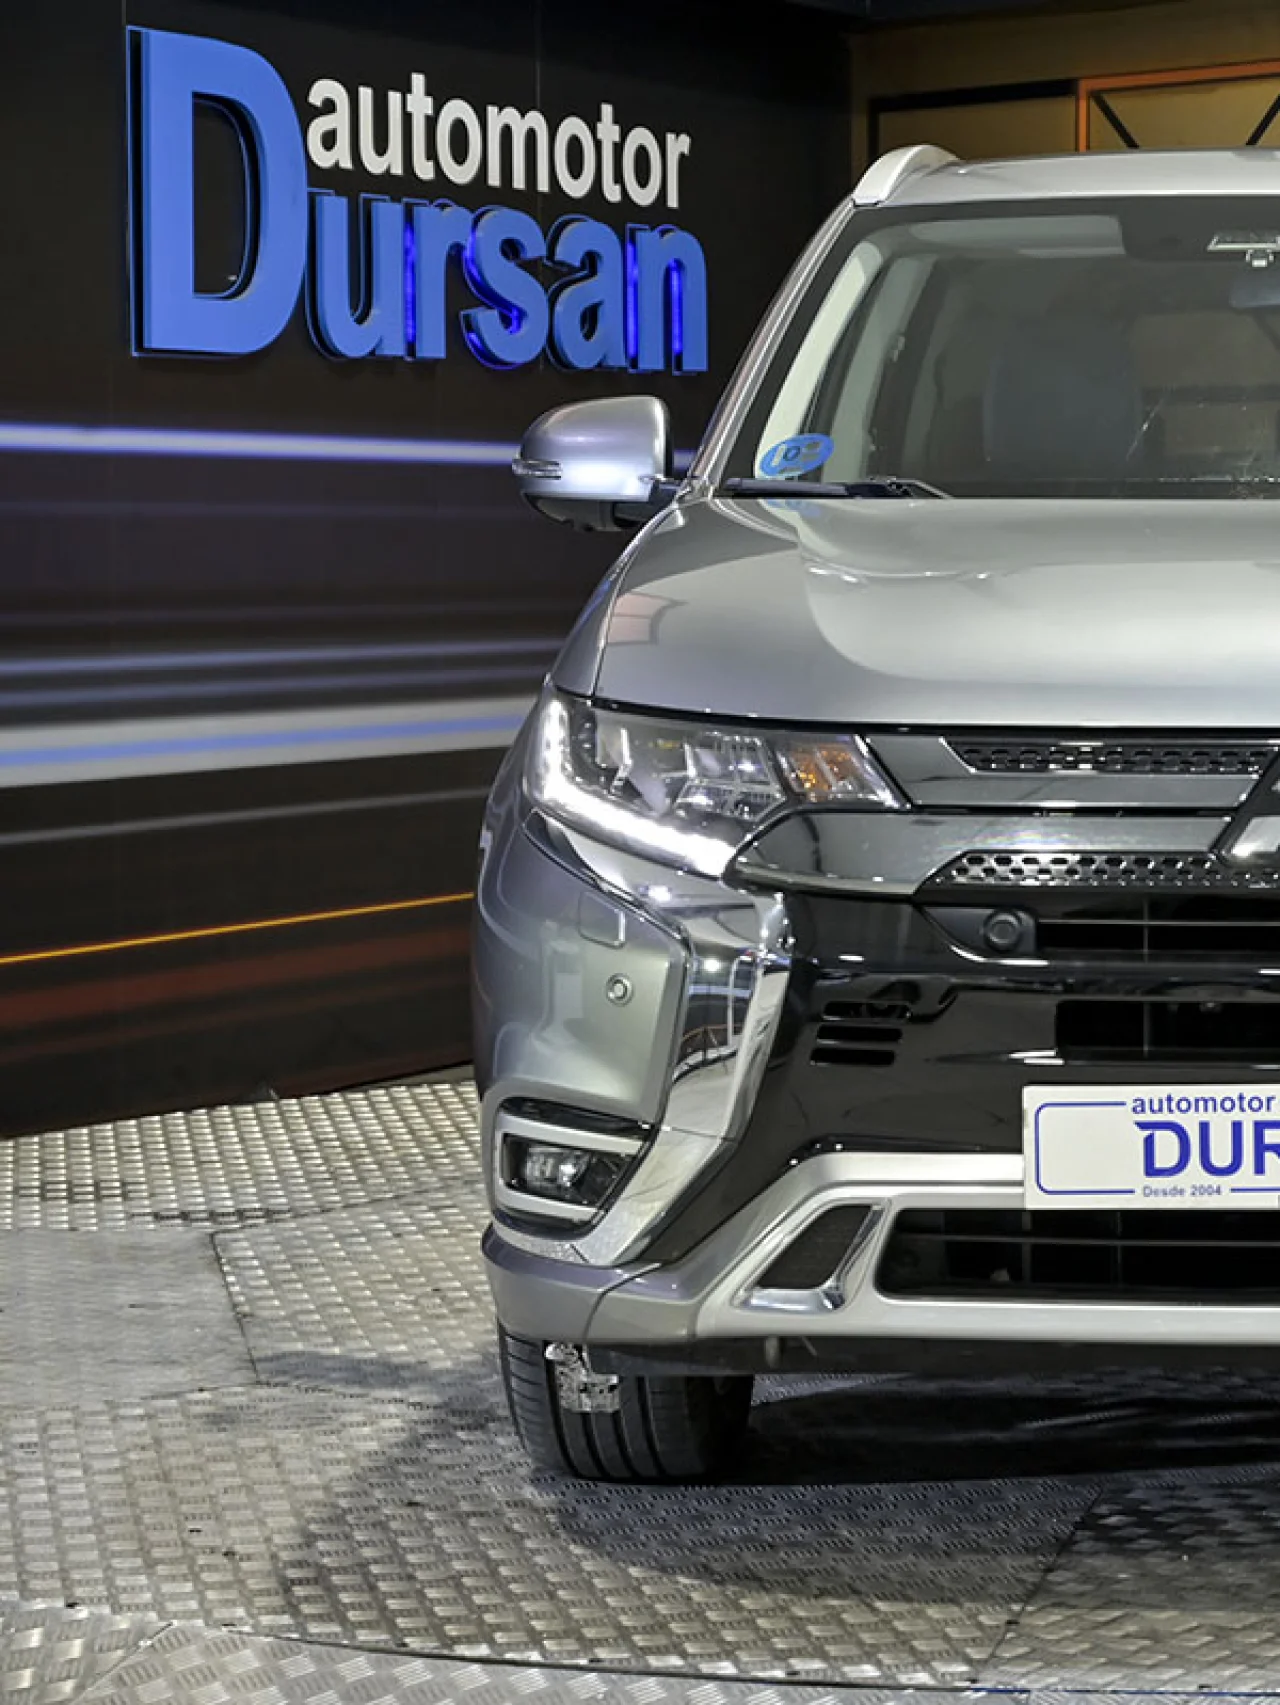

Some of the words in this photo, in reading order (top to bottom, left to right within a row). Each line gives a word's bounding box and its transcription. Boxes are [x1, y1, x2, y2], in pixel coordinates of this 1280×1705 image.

[306, 72, 692, 209] automotor
[126, 25, 709, 375] Dursan
[1131, 1092, 1276, 1114] automotor
[1143, 1185, 1185, 1197] Desde
[1190, 1184, 1222, 1196] 2004
